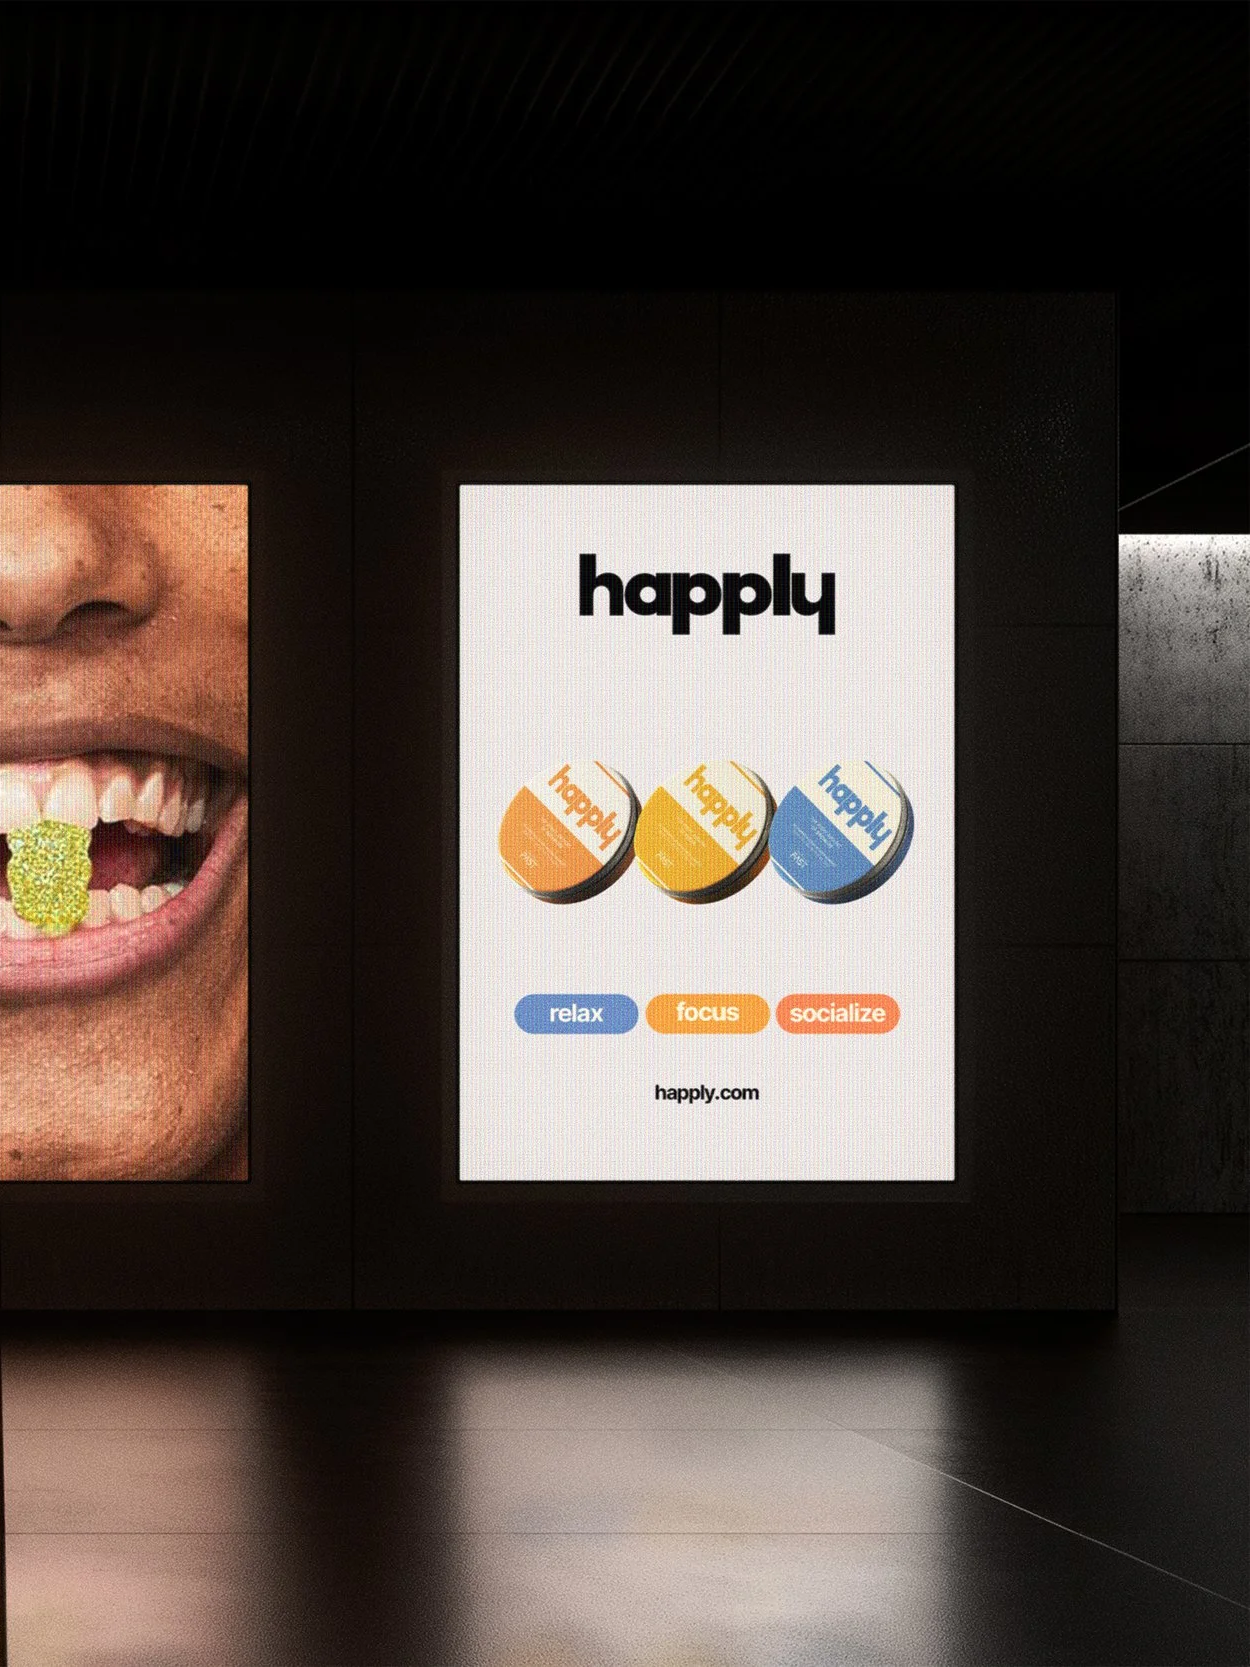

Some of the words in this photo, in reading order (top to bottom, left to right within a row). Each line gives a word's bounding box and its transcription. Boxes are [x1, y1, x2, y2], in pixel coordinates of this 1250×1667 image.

[579, 553, 836, 636] happly
[548, 764, 621, 851] happly
[683, 764, 758, 851] happly
[818, 764, 892, 851] happly
[550, 1002, 604, 1023] relax
[676, 1001, 740, 1022] focus
[789, 1002, 887, 1023] socialize
[655, 1084, 760, 1104] happly.com
